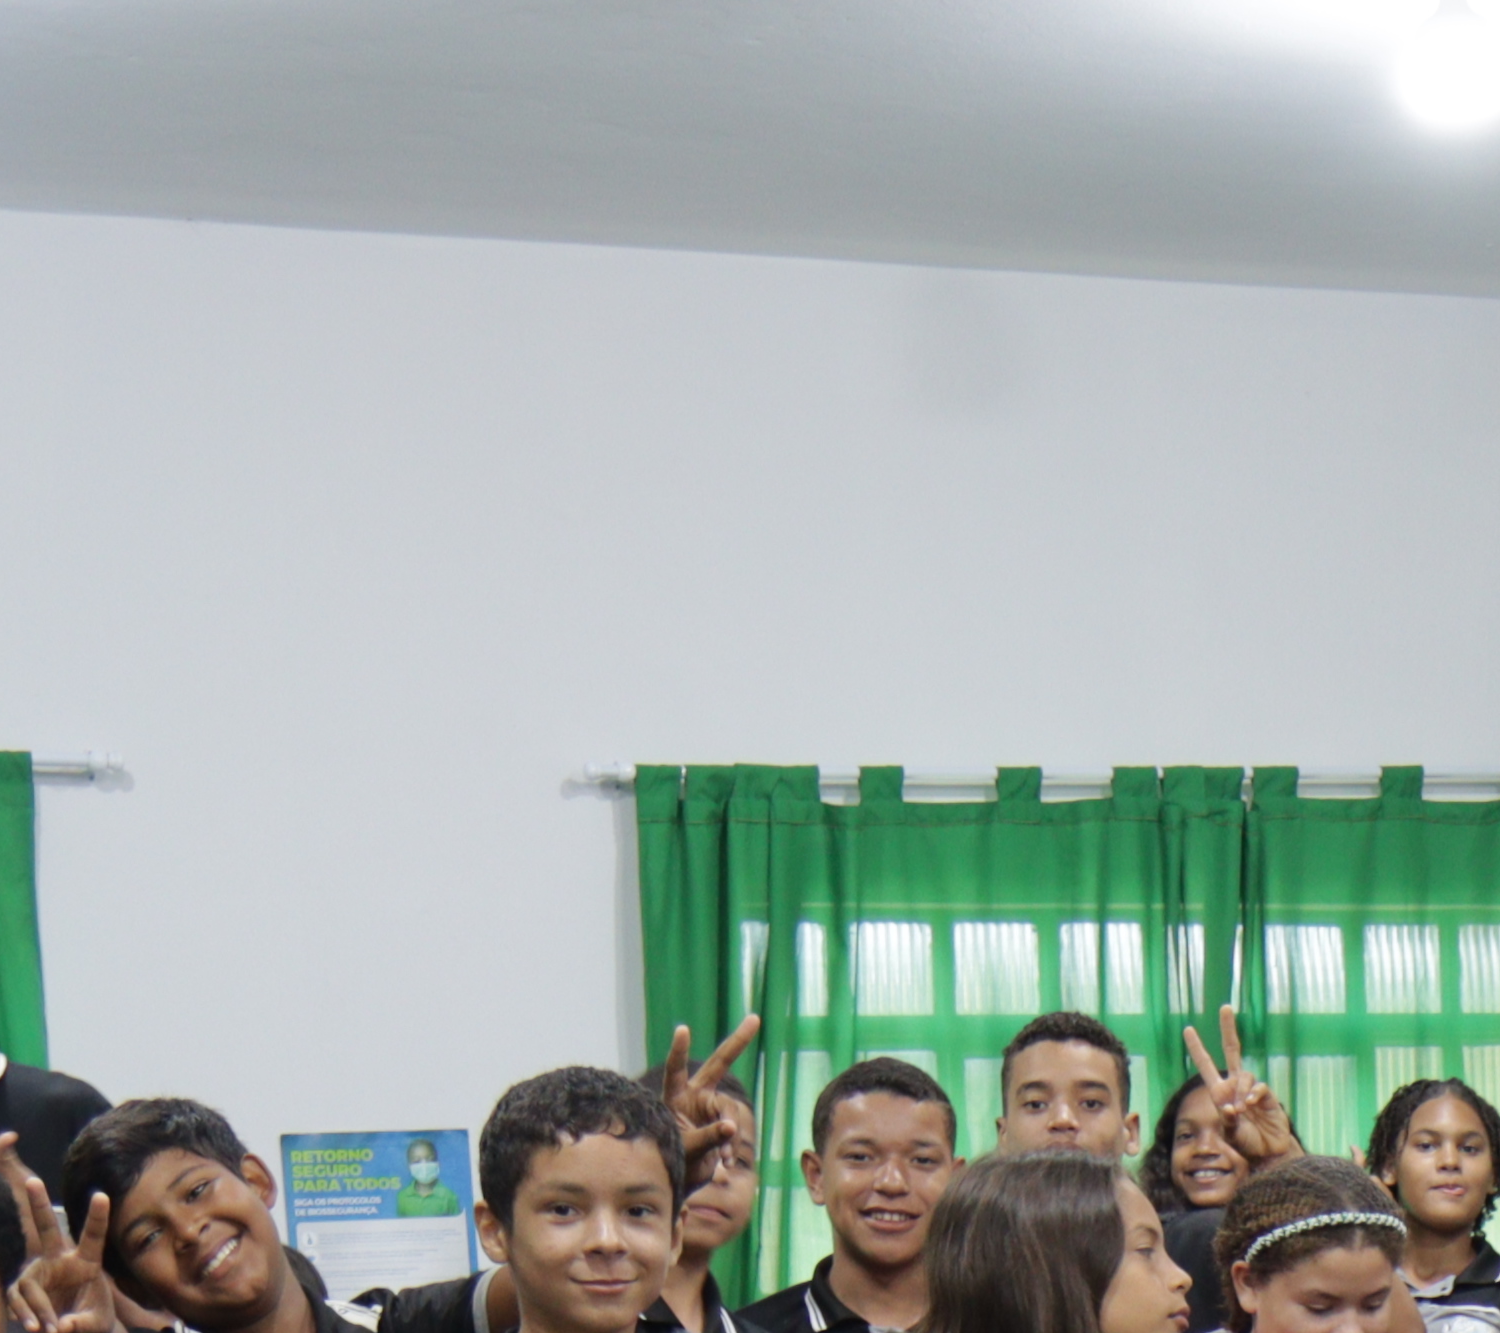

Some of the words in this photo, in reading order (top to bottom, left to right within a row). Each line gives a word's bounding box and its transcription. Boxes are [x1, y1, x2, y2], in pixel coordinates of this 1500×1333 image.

[291, 1149, 374, 1163] RETORNO
[292, 1164, 362, 1177] SEGURO
[293, 1179, 341, 1193] PARA
[344, 1176, 401, 1191] TODOS
[314, 1198, 326, 1206] OS
[327, 1196, 382, 1206] PROTOCOLOS
[295, 1208, 307, 1216] DE
